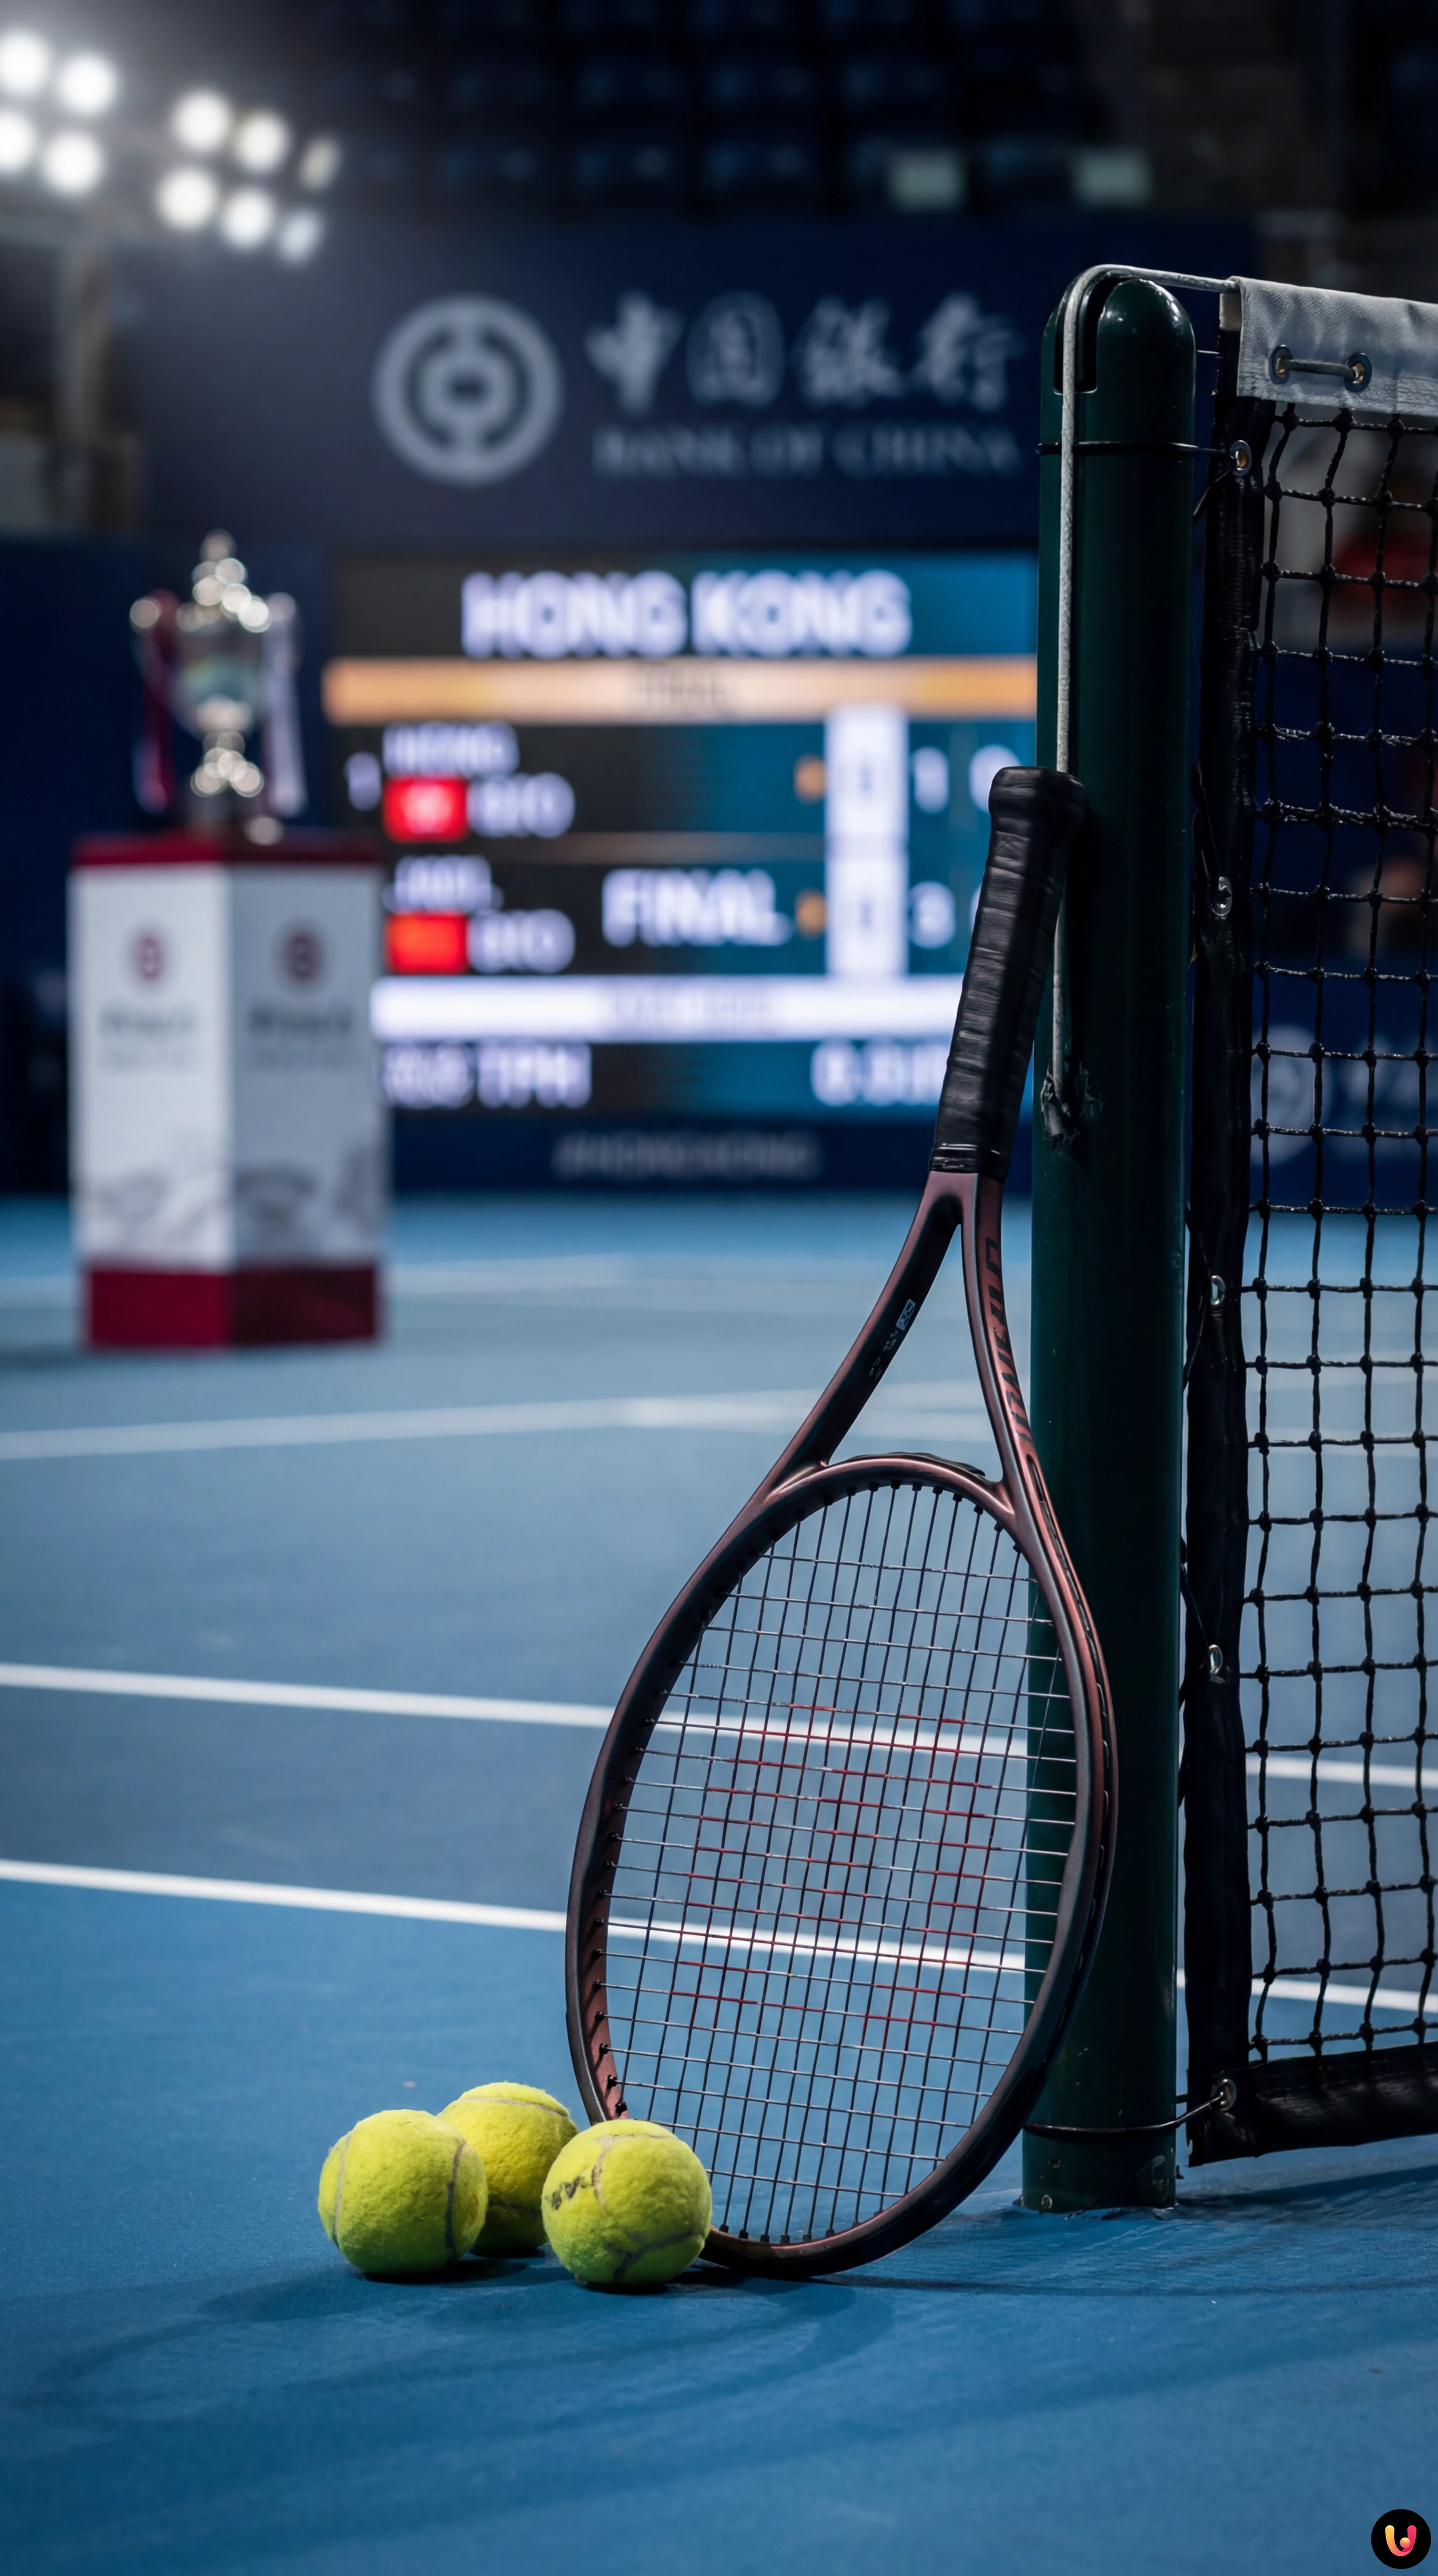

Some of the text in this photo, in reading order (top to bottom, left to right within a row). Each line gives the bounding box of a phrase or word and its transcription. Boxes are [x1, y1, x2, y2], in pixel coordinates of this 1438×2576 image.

[462, 570, 913, 658] HONG KONG
[603, 869, 791, 946] FINAL
